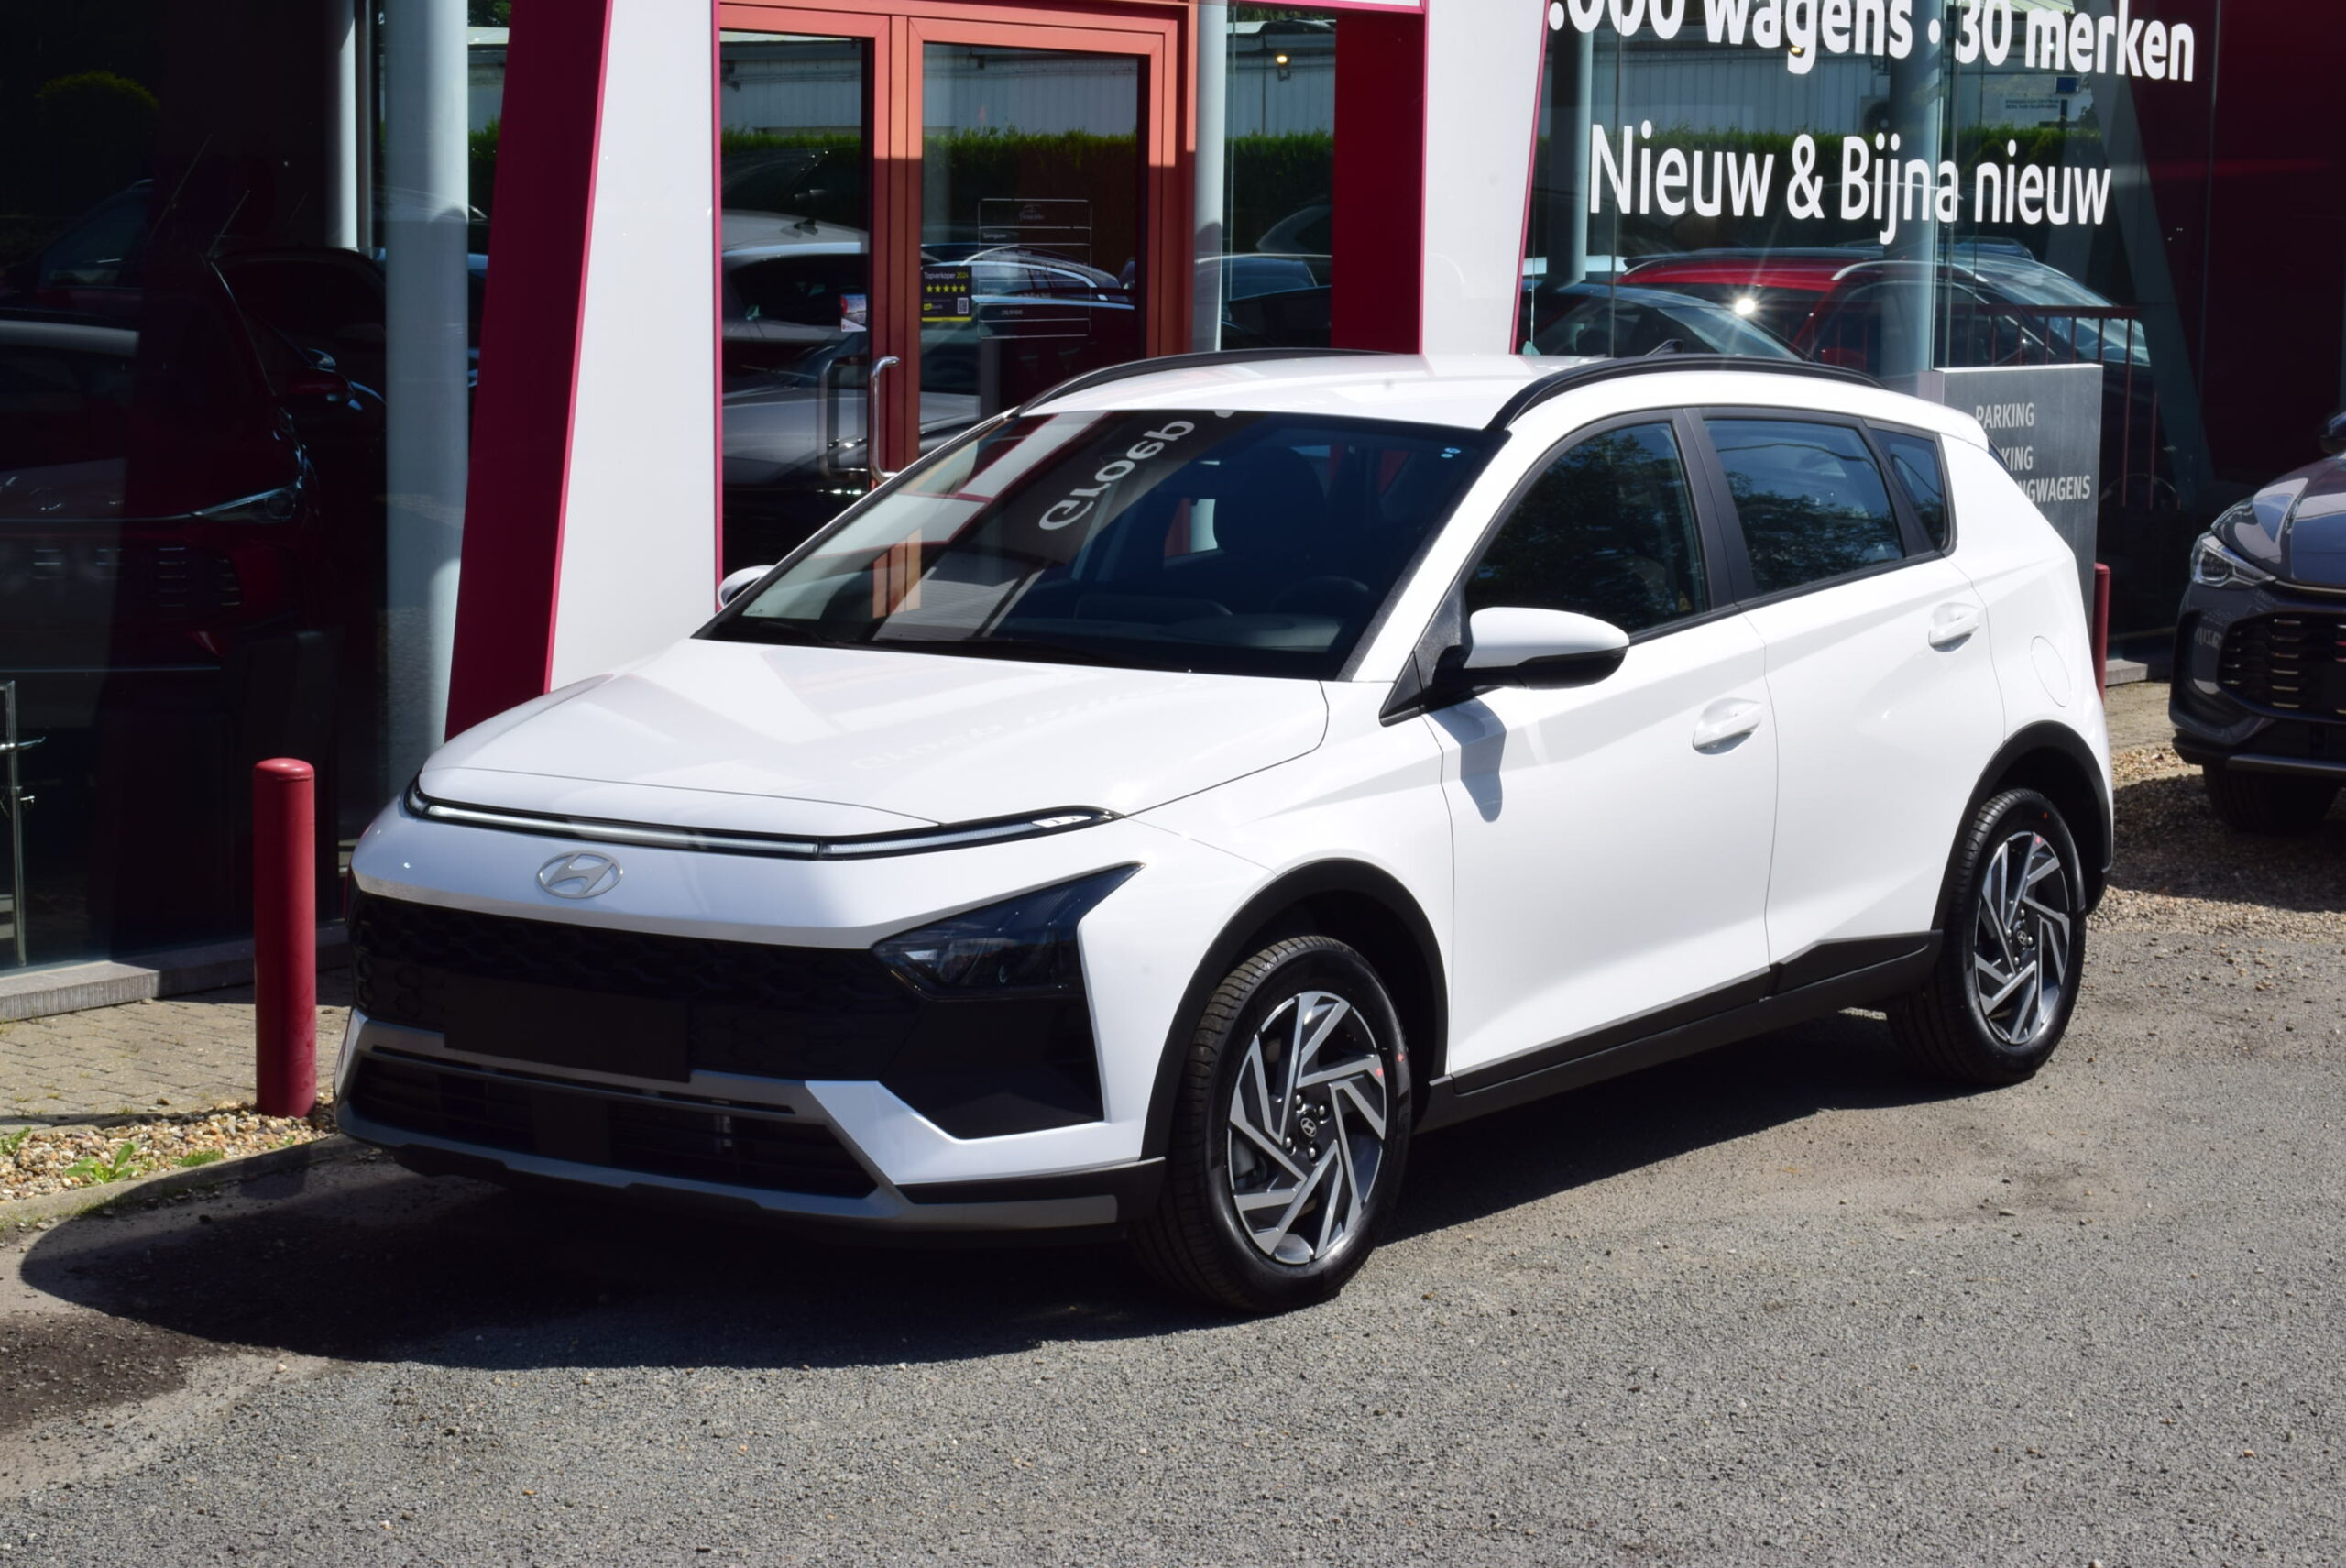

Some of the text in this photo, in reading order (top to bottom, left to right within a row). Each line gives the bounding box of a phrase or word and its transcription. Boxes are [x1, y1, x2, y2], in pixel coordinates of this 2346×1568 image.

[1703, 0, 1913, 75] wagens
[1954, 0, 2012, 67] 30
[2025, 0, 2195, 82] merken
[1589, 119, 2112, 245] Nieuw & Bijna nieuw
[1976, 402, 2034, 429] PARKING
